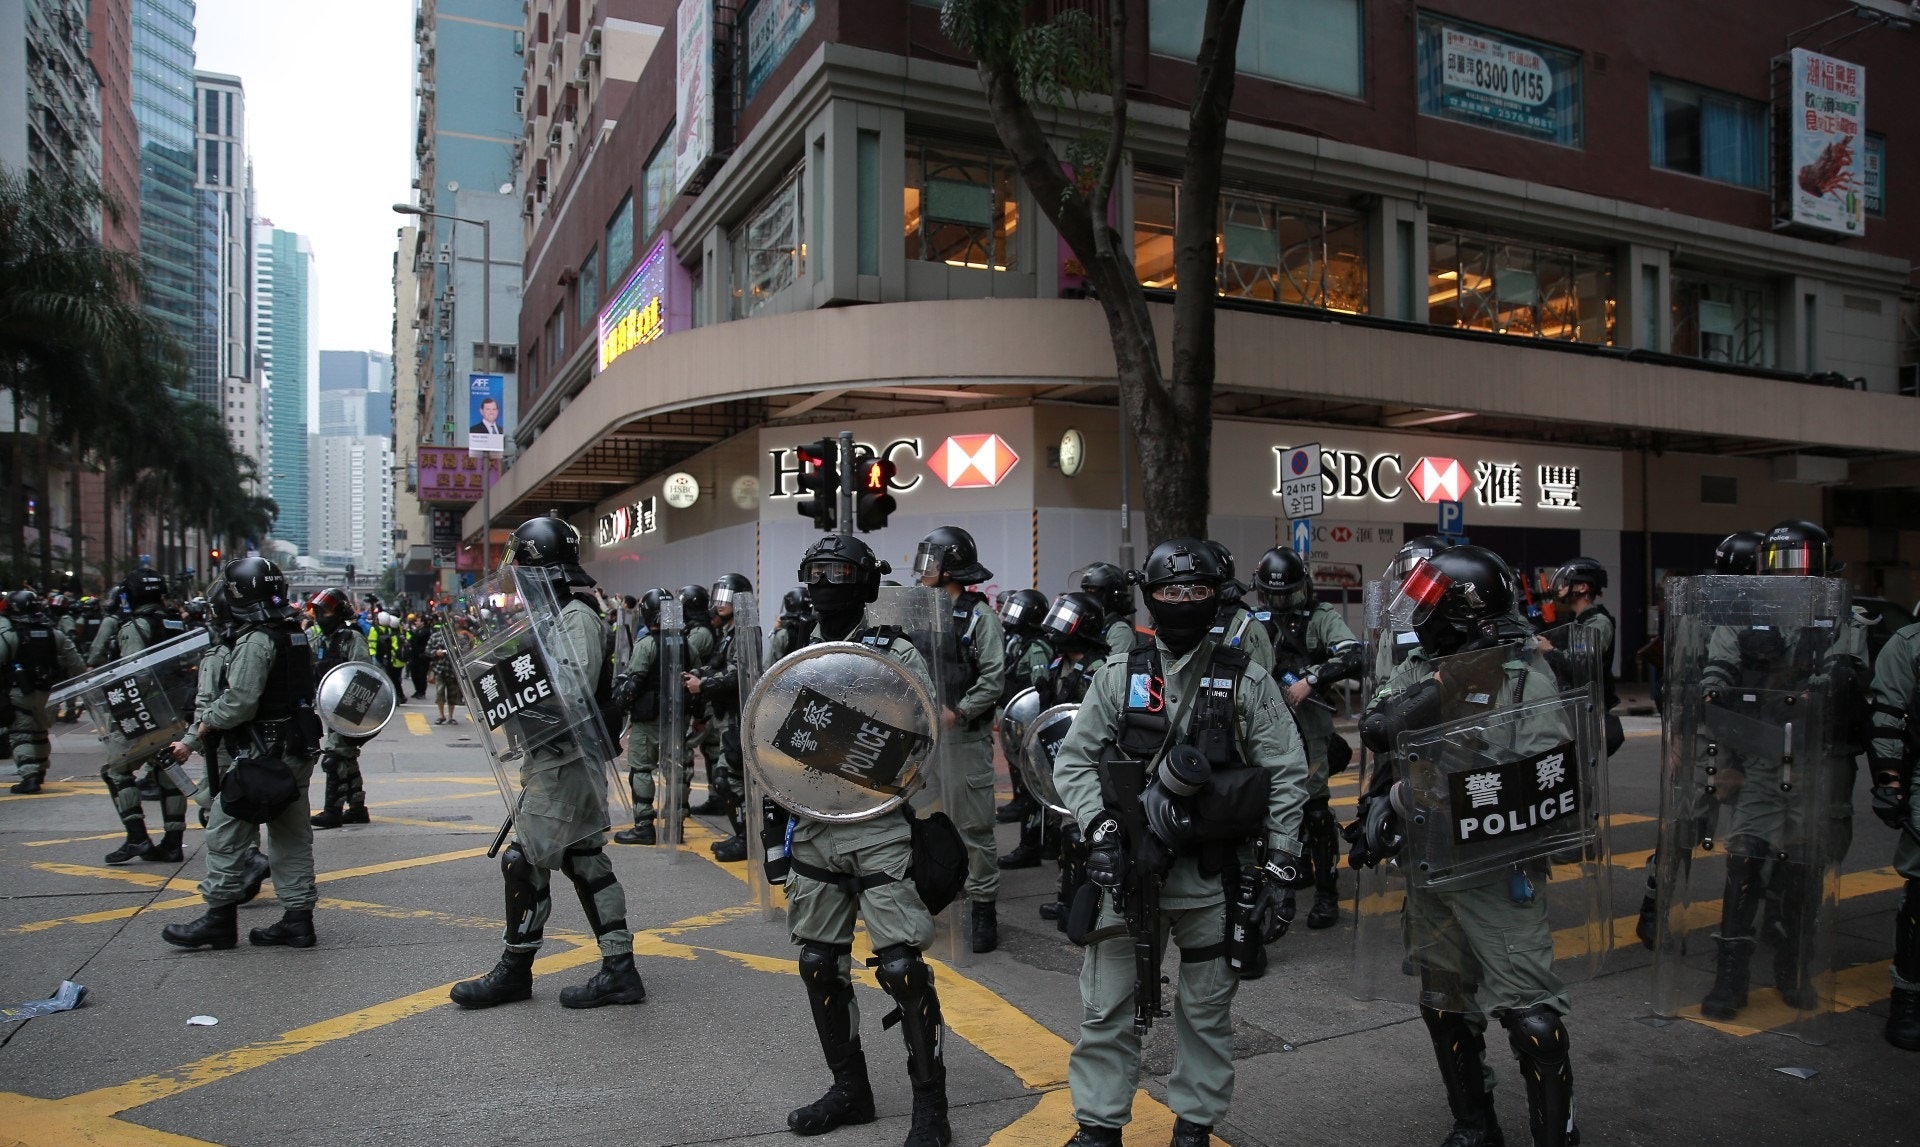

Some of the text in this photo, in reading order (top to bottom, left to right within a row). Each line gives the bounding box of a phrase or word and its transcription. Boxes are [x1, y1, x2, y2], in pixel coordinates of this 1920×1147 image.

[1476, 59, 1507, 93] 8300
[1512, 69, 1543, 102] 0155
[471, 378, 489, 387] AFF
[670, 485, 695, 494] HSBC
[769, 438, 922, 498] HC
[1286, 482, 1316, 496] 24 hrs
[1290, 495, 1314, 514] 全日
[1442, 502, 1459, 523] P
[348, 682, 376, 703] POLICE
[479, 654, 537, 702] 警察
[107, 688, 141, 733] 警察
[124, 678, 157, 730] POLICE
[486, 678, 552, 726] POLICE
[790, 700, 833, 752] 警察
[840, 722, 891, 779] POLICE
[1464, 752, 1566, 809] 警察
[1460, 789, 1575, 840] POLICE
